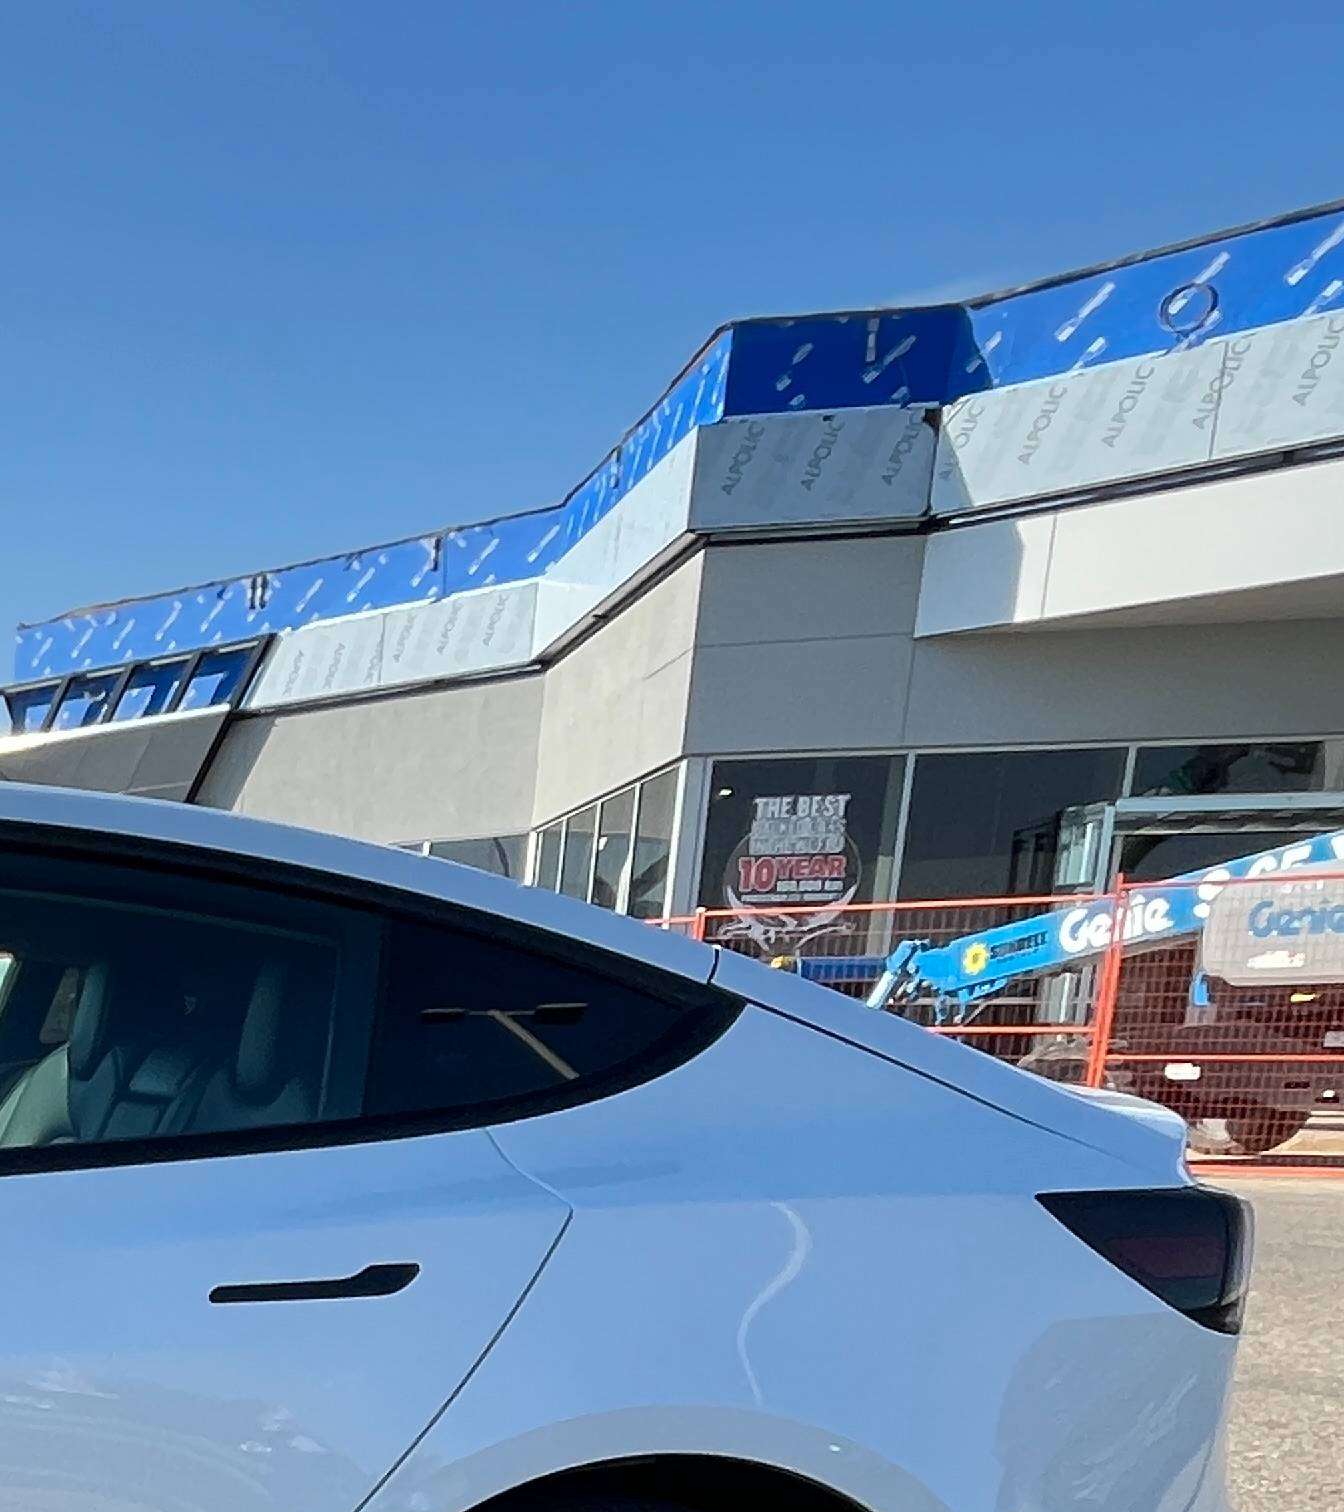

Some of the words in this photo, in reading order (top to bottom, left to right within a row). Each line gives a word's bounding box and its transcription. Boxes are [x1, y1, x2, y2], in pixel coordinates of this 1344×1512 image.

[1101, 364, 1155, 448] ALPOLIC
[1192, 340, 1252, 430] ALPOLIC
[721, 421, 765, 496] ALPOLIC
[801, 418, 845, 491] ALPOLIC
[1017, 384, 1067, 465] ALPOLIC
[754, 797, 791, 818] THE
[798, 794, 852, 817] BEST
[738, 856, 777, 892] 10
[776, 855, 847, 879] YEAR
